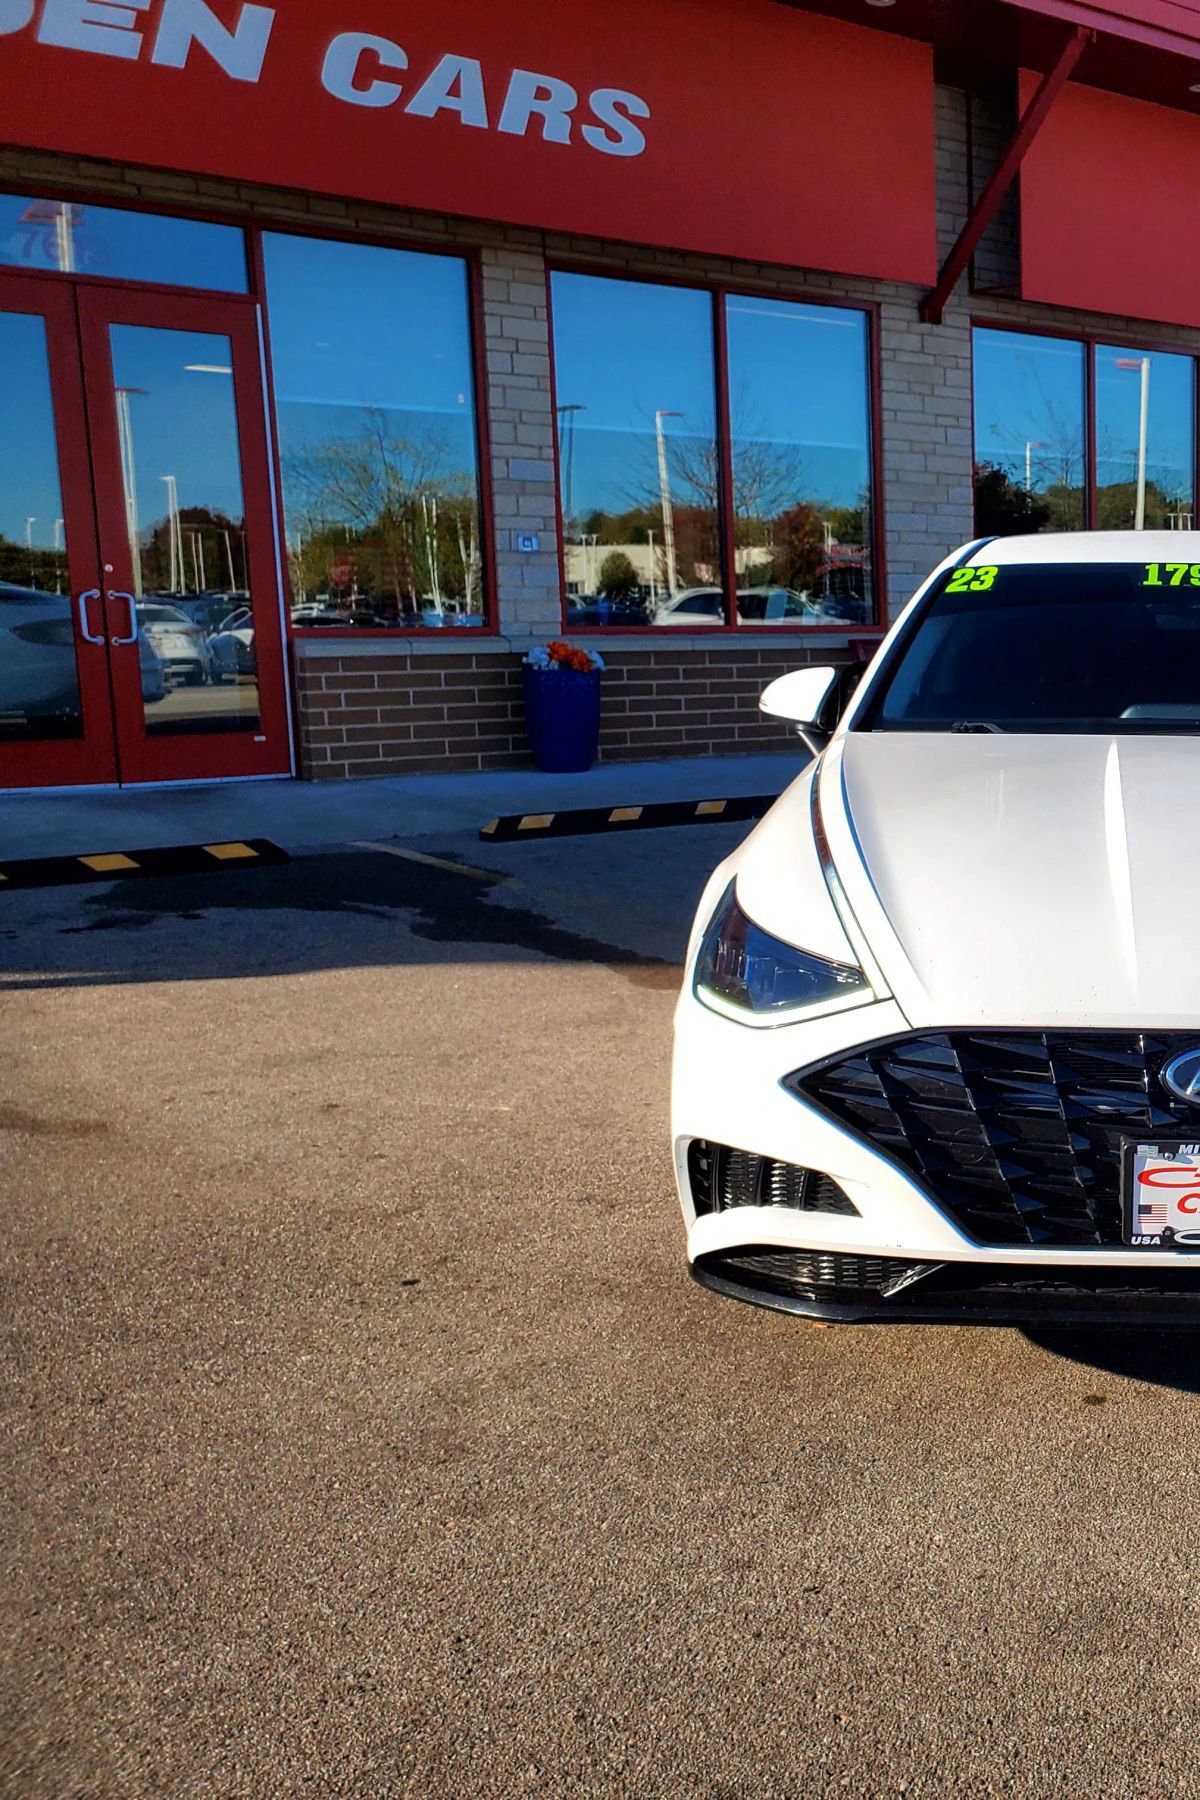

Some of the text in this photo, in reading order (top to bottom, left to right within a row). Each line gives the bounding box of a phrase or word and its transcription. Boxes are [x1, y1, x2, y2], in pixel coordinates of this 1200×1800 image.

[0, 0, 651, 157] EN CARS
[945, 566, 999, 593] 23
[1130, 1236, 1161, 1245] USA
